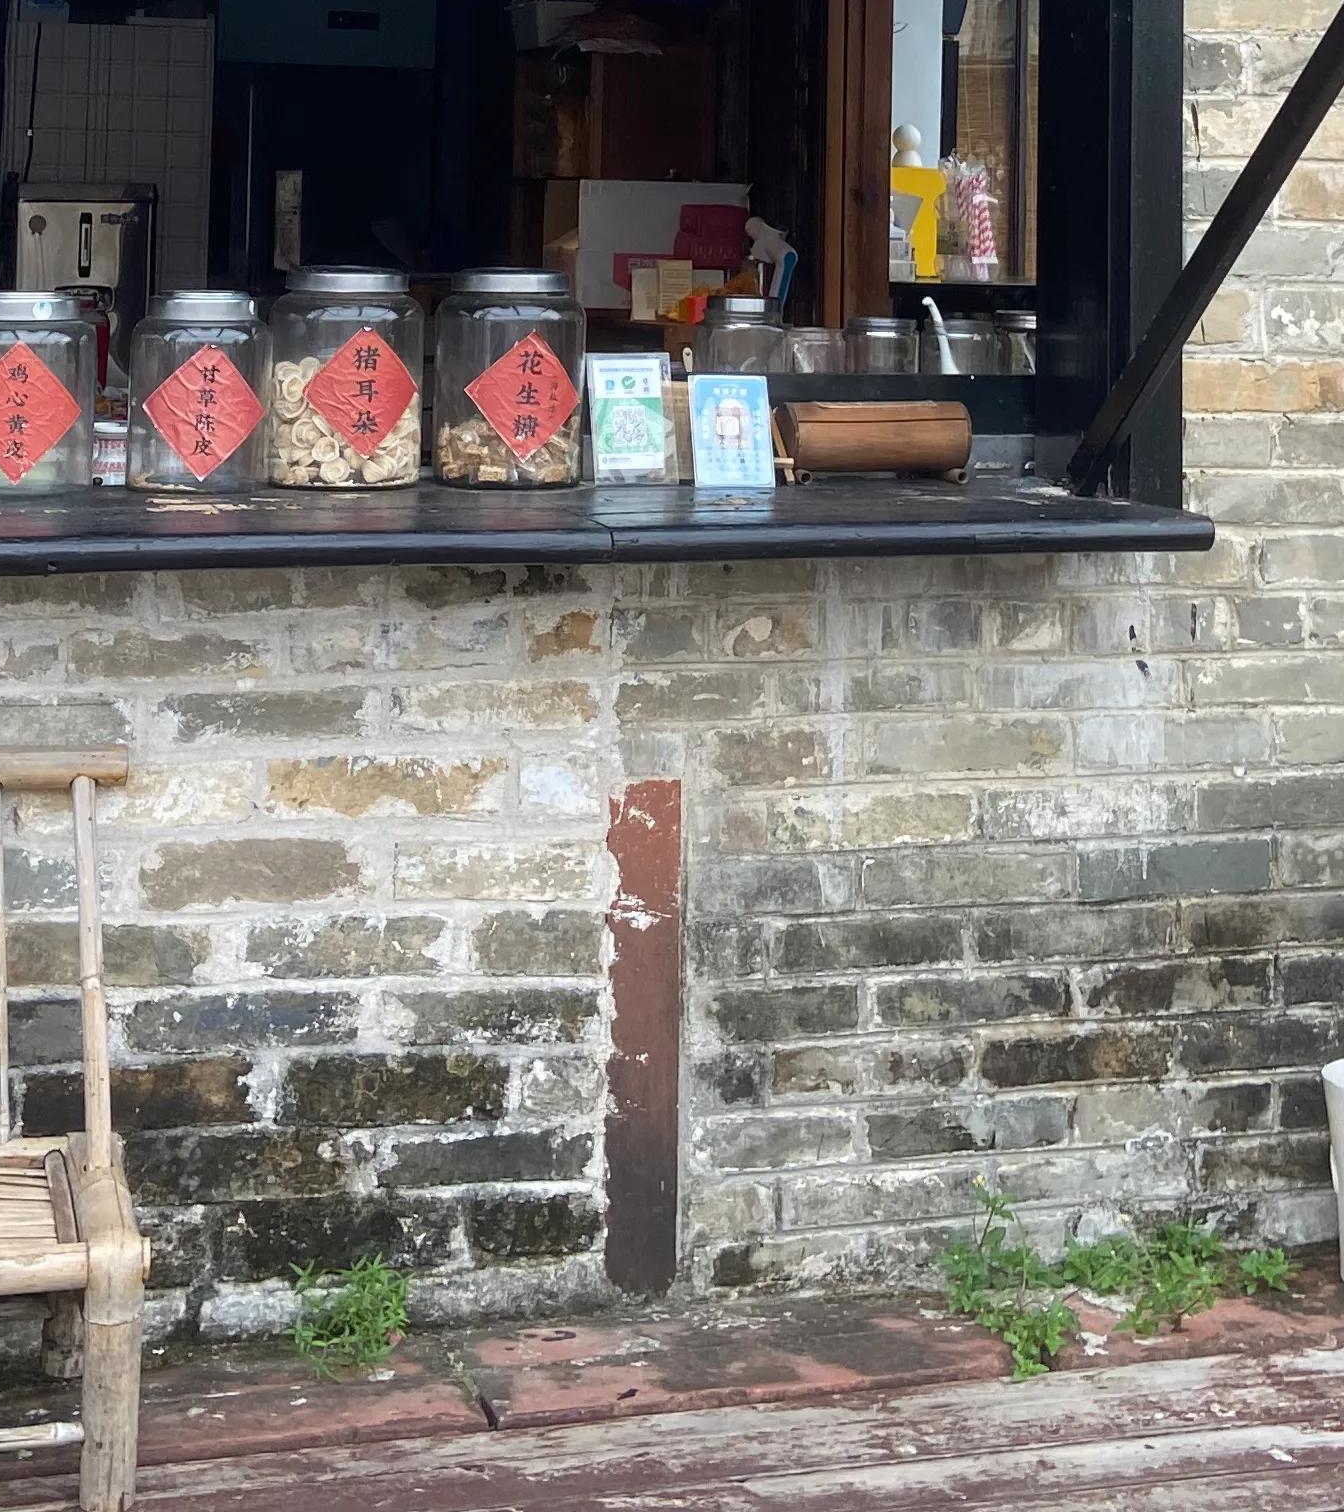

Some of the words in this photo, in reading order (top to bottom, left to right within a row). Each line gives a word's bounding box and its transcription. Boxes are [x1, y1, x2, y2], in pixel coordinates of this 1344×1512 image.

[6, 363, 29, 459] 鸡心黄皮
[191, 364, 221, 457] 甘草陈皮
[351, 345, 381, 435] 猪耳朵
[514, 350, 544, 439] 花生糖
